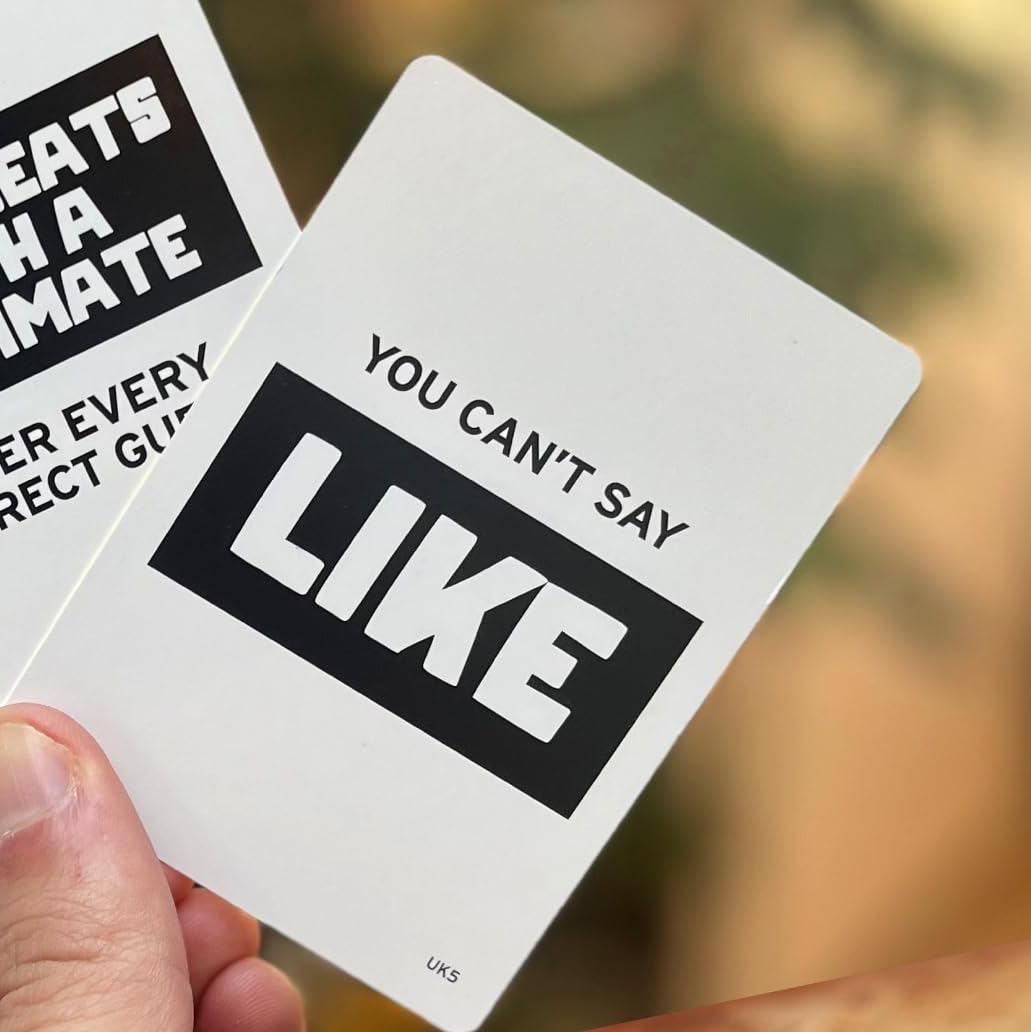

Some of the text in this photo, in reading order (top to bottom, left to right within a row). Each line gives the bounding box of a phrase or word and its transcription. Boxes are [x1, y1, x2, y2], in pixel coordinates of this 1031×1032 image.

[53, 186, 114, 255] A
[61, 341, 209, 442] EVERY
[365, 333, 690, 550] YOU CAN'T SAY
[229, 431, 628, 743] LIKE
[427, 956, 460, 983] UK5
